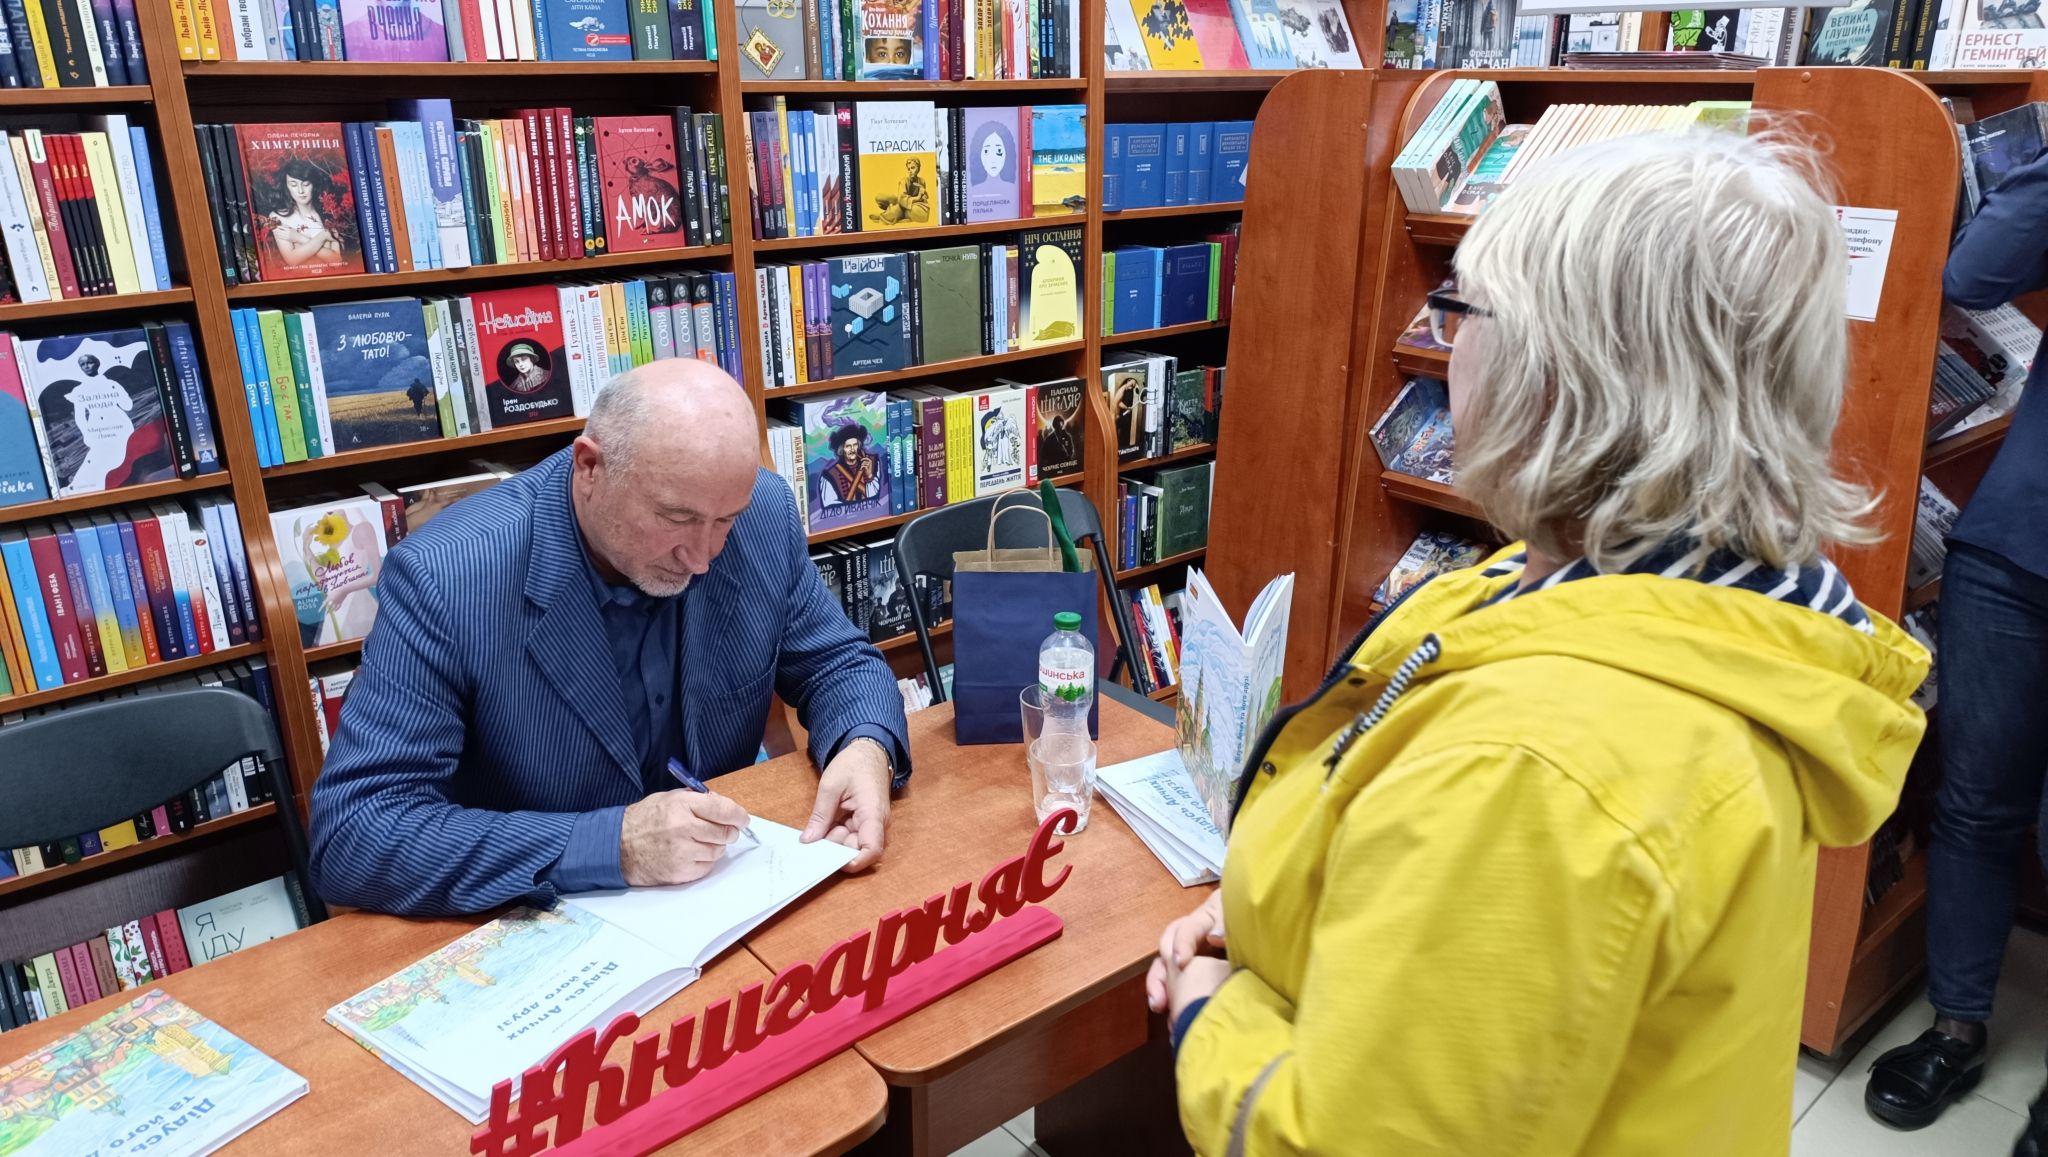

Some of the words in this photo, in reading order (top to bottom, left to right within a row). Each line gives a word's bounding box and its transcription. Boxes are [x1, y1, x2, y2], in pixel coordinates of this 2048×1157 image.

[862, 9, 909, 30] КОХАННЯ
[1830, 13, 1869, 28] ВЕЛИКА
[240, 15, 253, 48] Вибрані
[1824, 26, 1871, 40] ГЛУШИНА
[1964, 33, 2024, 46] ЕРНЕСТ
[1461, 58, 1509, 69] БАКМАН
[1468, 48, 1503, 59] Фредрік
[1961, 45, 2047, 61] ГЕМІНҐВЕЙ
[251, 138, 340, 152] ХИМЕРНИЦЯ
[290, 131, 321, 139] ПЕЧОРНА
[869, 139, 926, 153] ТАРАСИК
[1038, 153, 1052, 163] THE
[1053, 153, 1085, 164] UKRAINE
[360, 177, 371, 207] ЗАТІНКУ
[375, 177, 386, 207] ЗАТІНКУ
[365, 208, 376, 236] ЗЕМНОЇ
[379, 208, 390, 236] ЗЕМНОЇ
[503, 200, 512, 239] ПЛУЖНИК
[615, 194, 676, 238] АМОК
[844, 202, 853, 230] БОГДАН
[1024, 233, 1040, 245] НІЧ
[1042, 228, 1082, 243] ОСТАННЯ
[369, 237, 379, 260] ЖІНКИ
[384, 237, 394, 260] ЖІНКИ
[942, 255, 960, 263] ТОЧКА
[962, 252, 978, 260] НУЛЬ
[348, 312, 370, 320] ВАЛЕРІЙ
[679, 308, 690, 343] СОФІЯ
[700, 308, 711, 342] СОФІЯ
[795, 309, 804, 339] ЩАСТЯ
[657, 310, 669, 347] СОФІЯ
[337, 335, 346, 351] З
[361, 346, 390, 361] ТАТО!
[78, 389, 120, 403] Залізна
[502, 397, 518, 406] Ірен
[1050, 385, 1078, 397] ВАСИЛЬ
[88, 399, 115, 411] вода
[504, 398, 559, 413] РОЗДОБУДЬКО
[1040, 392, 1082, 415] ШКЛЯР
[893, 442, 901, 477] ОПРИШКИ
[905, 440, 915, 475] ОПРИШКИ
[795, 466, 805, 482] ДІДО
[1005, 474, 1022, 483] ЖИТТЯ
[820, 507, 843, 520] ДІДО
[314, 552, 355, 577] Любов
[48, 573, 61, 594] ФЕБА
[51, 597, 65, 617] ІВАН
[297, 597, 319, 605] ALINA
[297, 603, 317, 611] ROSS
[1234, 743, 1243, 764] Дідусь
[1241, 675, 1249, 694] друзі
[1149, 779, 1180, 807] Апчих
[1161, 777, 1192, 800] друзі
[195, 912, 216, 937] Я
[201, 926, 245, 960] ІДУ
[576, 960, 600, 973] та
[543, 973, 580, 1001] його
[564, 960, 619, 1004] Дідусь
[496, 1002, 542, 1031] друзі
[505, 1004, 564, 1041] Апчих
[168, 1093, 197, 1112] та
[109, 1112, 166, 1149] його
[131, 1097, 217, 1153] Дідусь
